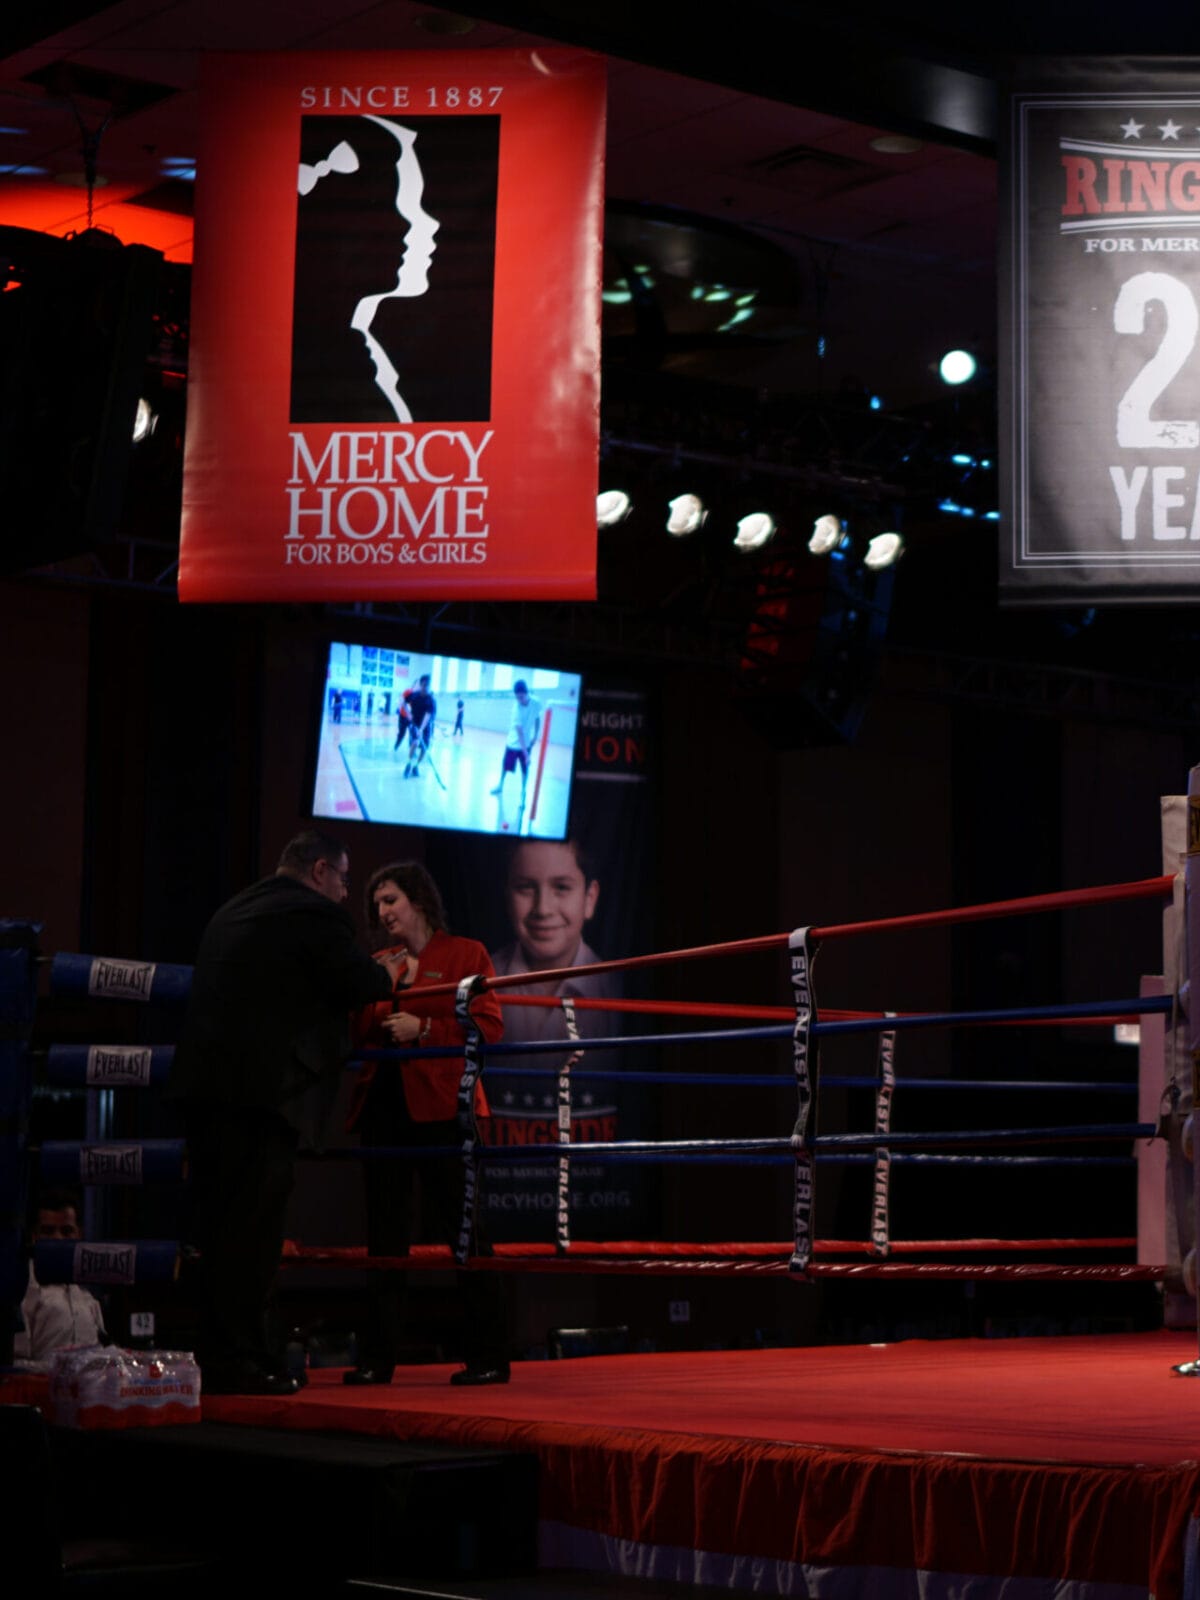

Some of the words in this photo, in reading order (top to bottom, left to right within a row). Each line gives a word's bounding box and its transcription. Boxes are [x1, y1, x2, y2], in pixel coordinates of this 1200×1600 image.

[301, 86, 410, 108] SINCE
[426, 86, 504, 108] 1887
[1084, 237, 1135, 253] FOR
[288, 430, 495, 484] MERCY
[284, 486, 490, 540] HOME
[285, 543, 331, 566] FOR
[336, 543, 393, 565] BOYS
[96, 963, 151, 994] EVERLAST
[456, 989, 479, 1104] EVRLAST
[94, 1050, 148, 1080] EVERLAST
[87, 1151, 138, 1179] EVERLAST
[558, 1130, 573, 1242] EERLAST
[81, 1249, 133, 1274] EVERLAST
